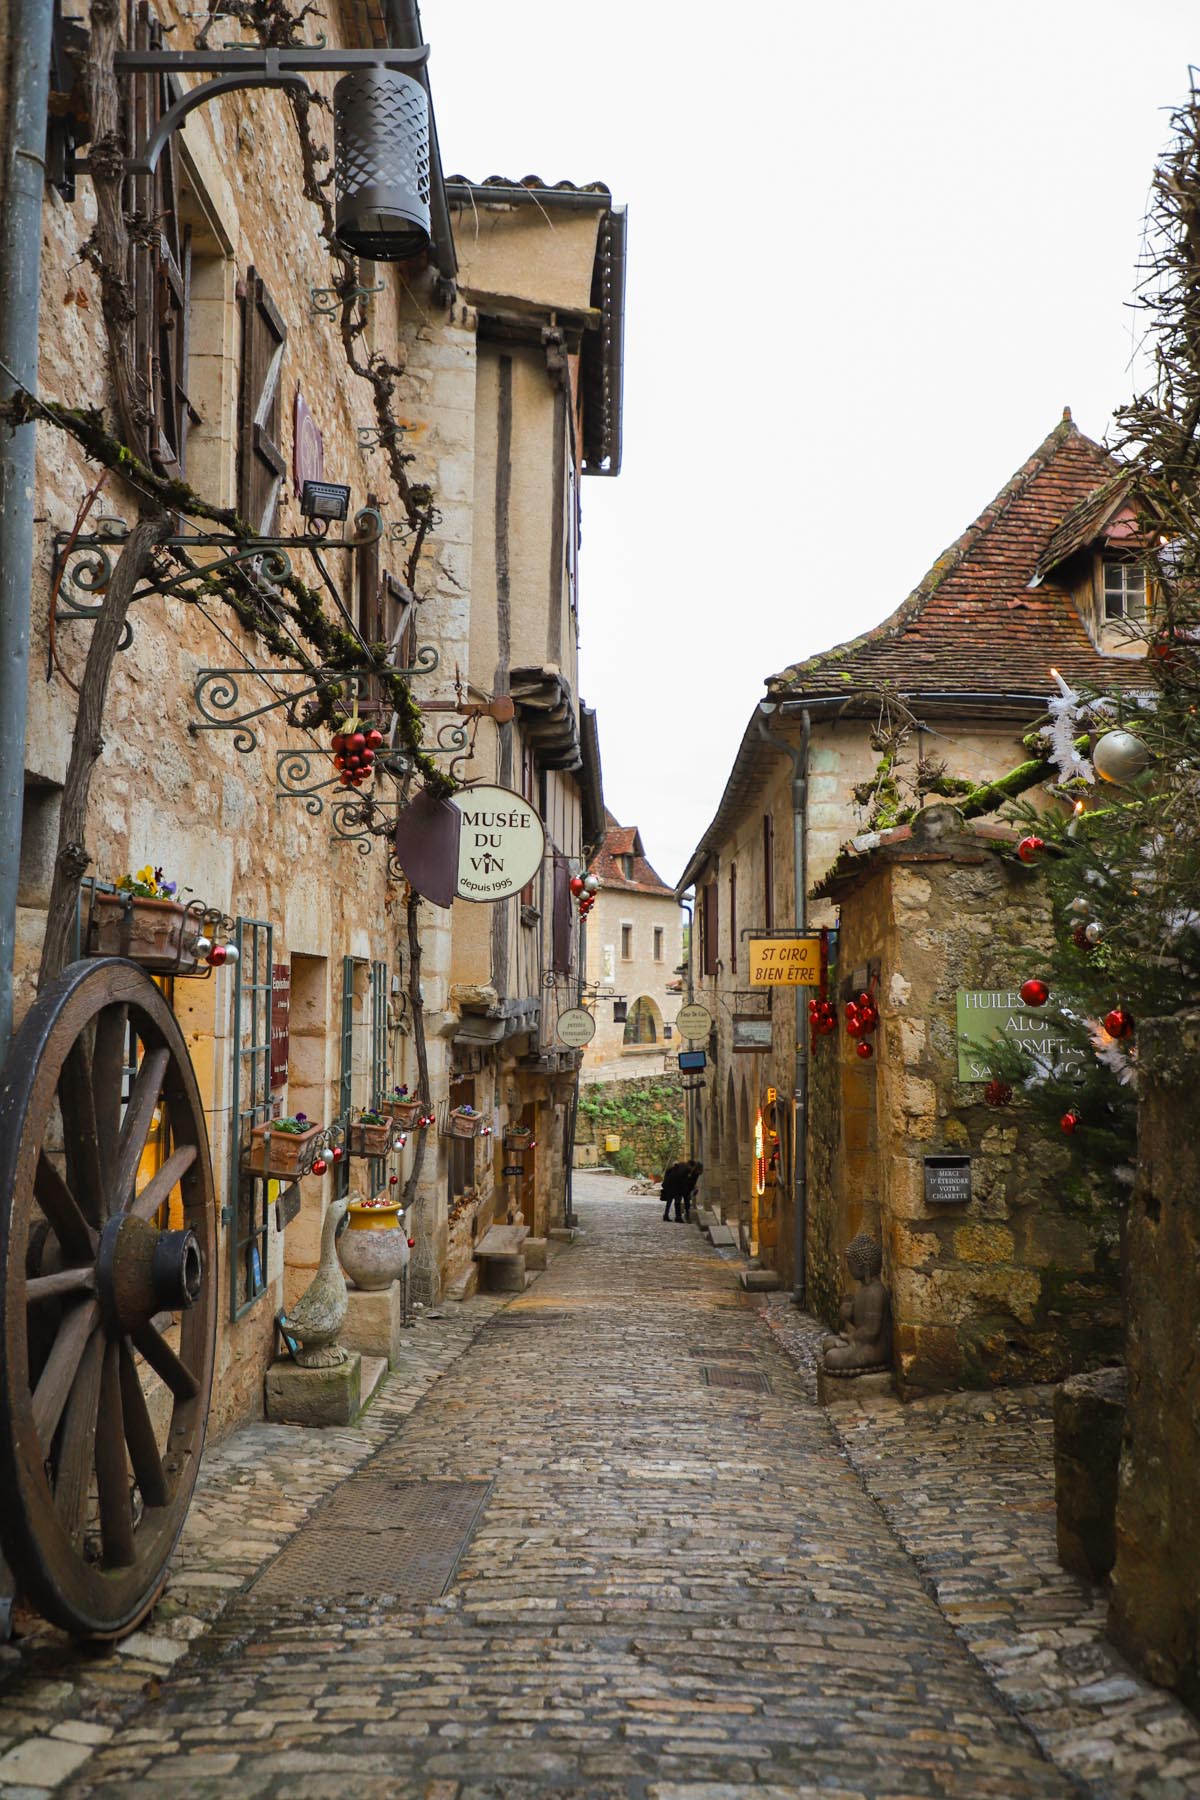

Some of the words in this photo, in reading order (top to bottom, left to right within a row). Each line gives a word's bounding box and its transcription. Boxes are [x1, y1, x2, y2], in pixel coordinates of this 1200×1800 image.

[462, 810, 531, 828] MUSÉE
[474, 834, 502, 848] DU
[470, 854, 505, 874] VIN
[460, 877, 491, 892] depuis
[492, 878, 513, 891] 1995
[762, 948, 776, 961] ST
[779, 948, 808, 962] CIRQ
[755, 968, 783, 980] BIEN
[787, 965, 815, 980] ÊTRE
[965, 992, 1026, 1009] HUILES
